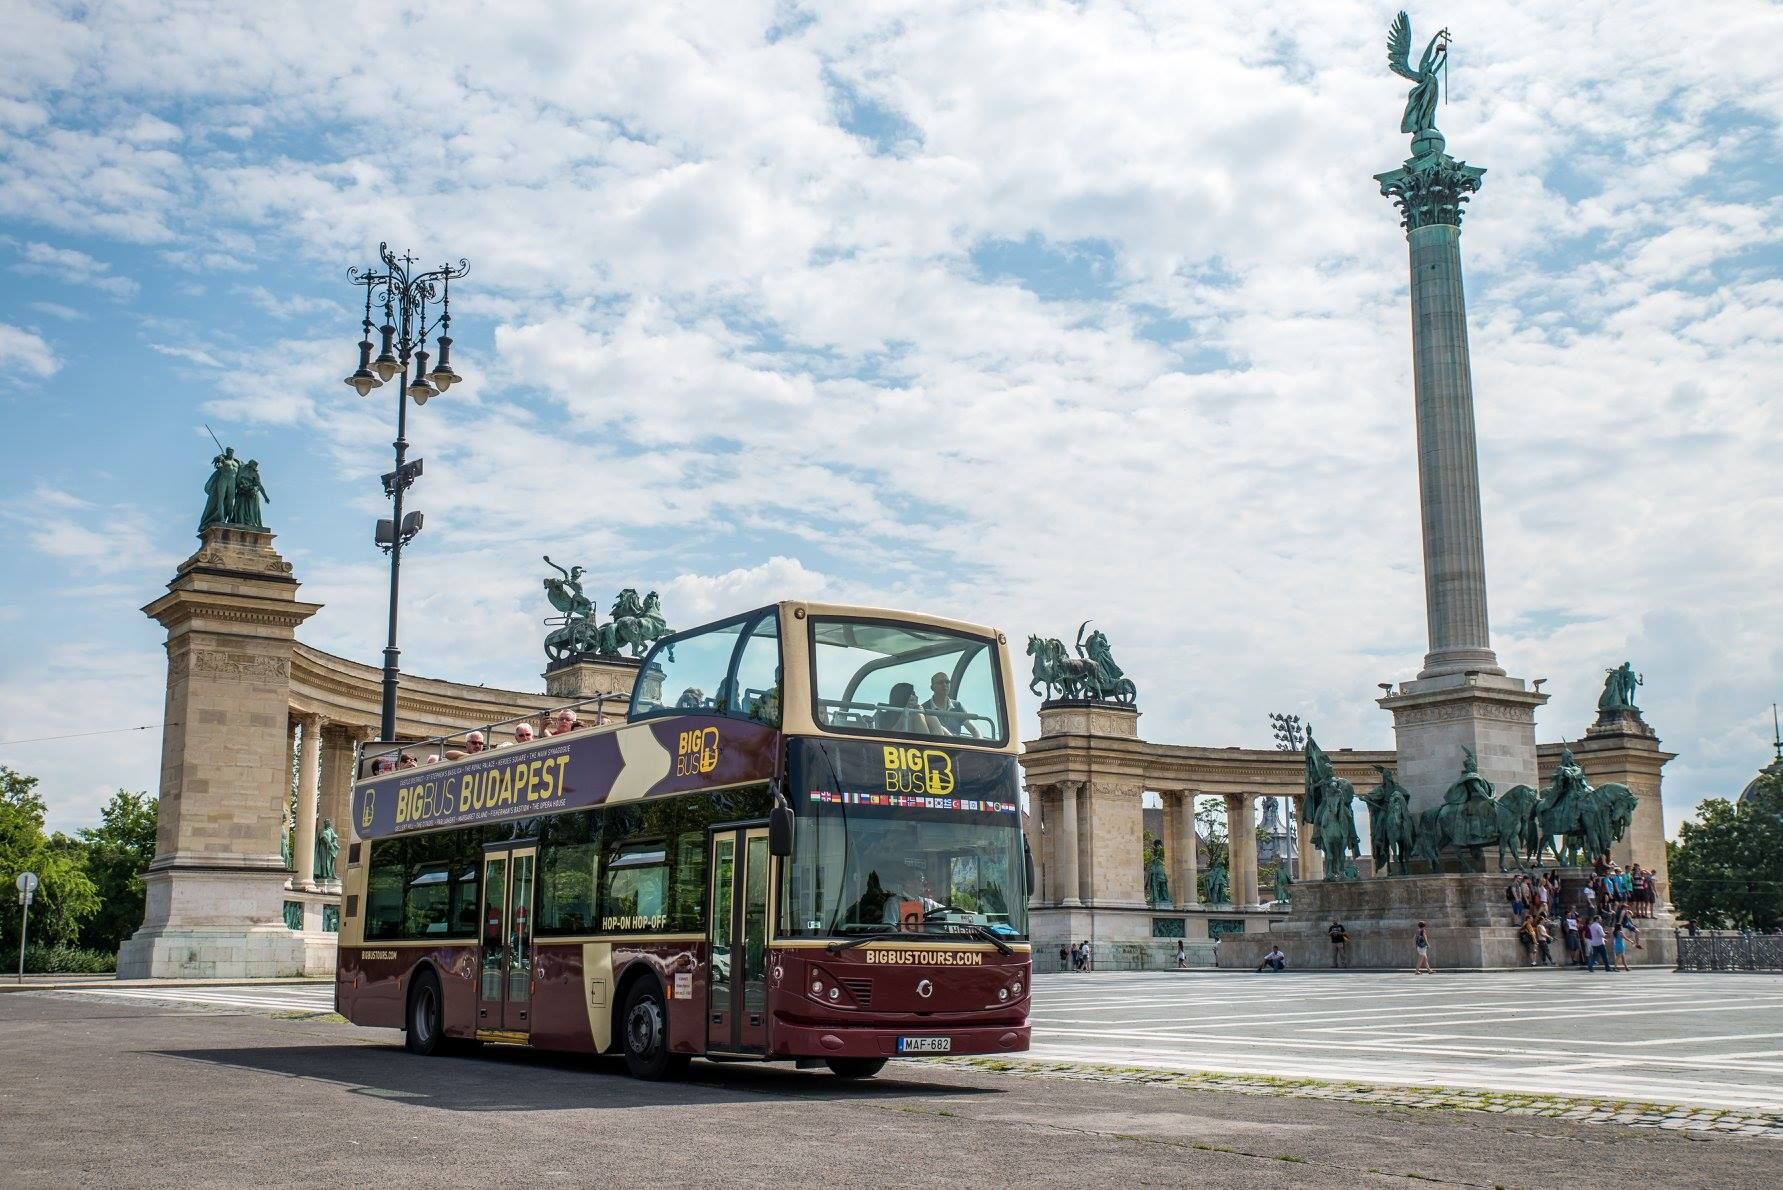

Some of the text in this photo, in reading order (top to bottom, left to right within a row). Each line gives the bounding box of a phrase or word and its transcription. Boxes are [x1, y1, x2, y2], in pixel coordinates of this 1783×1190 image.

[679, 730, 701, 755] BIG
[677, 754, 700, 776] BUS
[884, 746, 922, 771] BIG
[460, 755, 570, 812] BUDAPEST
[886, 770, 924, 794] BUS
[540, 800, 552, 809] OPERA
[553, 798, 566, 807] HOUSE
[602, 914, 666, 930] HOP-ON HOP-OFF
[866, 950, 982, 965] BIGBUSTOURS.COM
[906, 1040, 948, 1050] MAF-682
